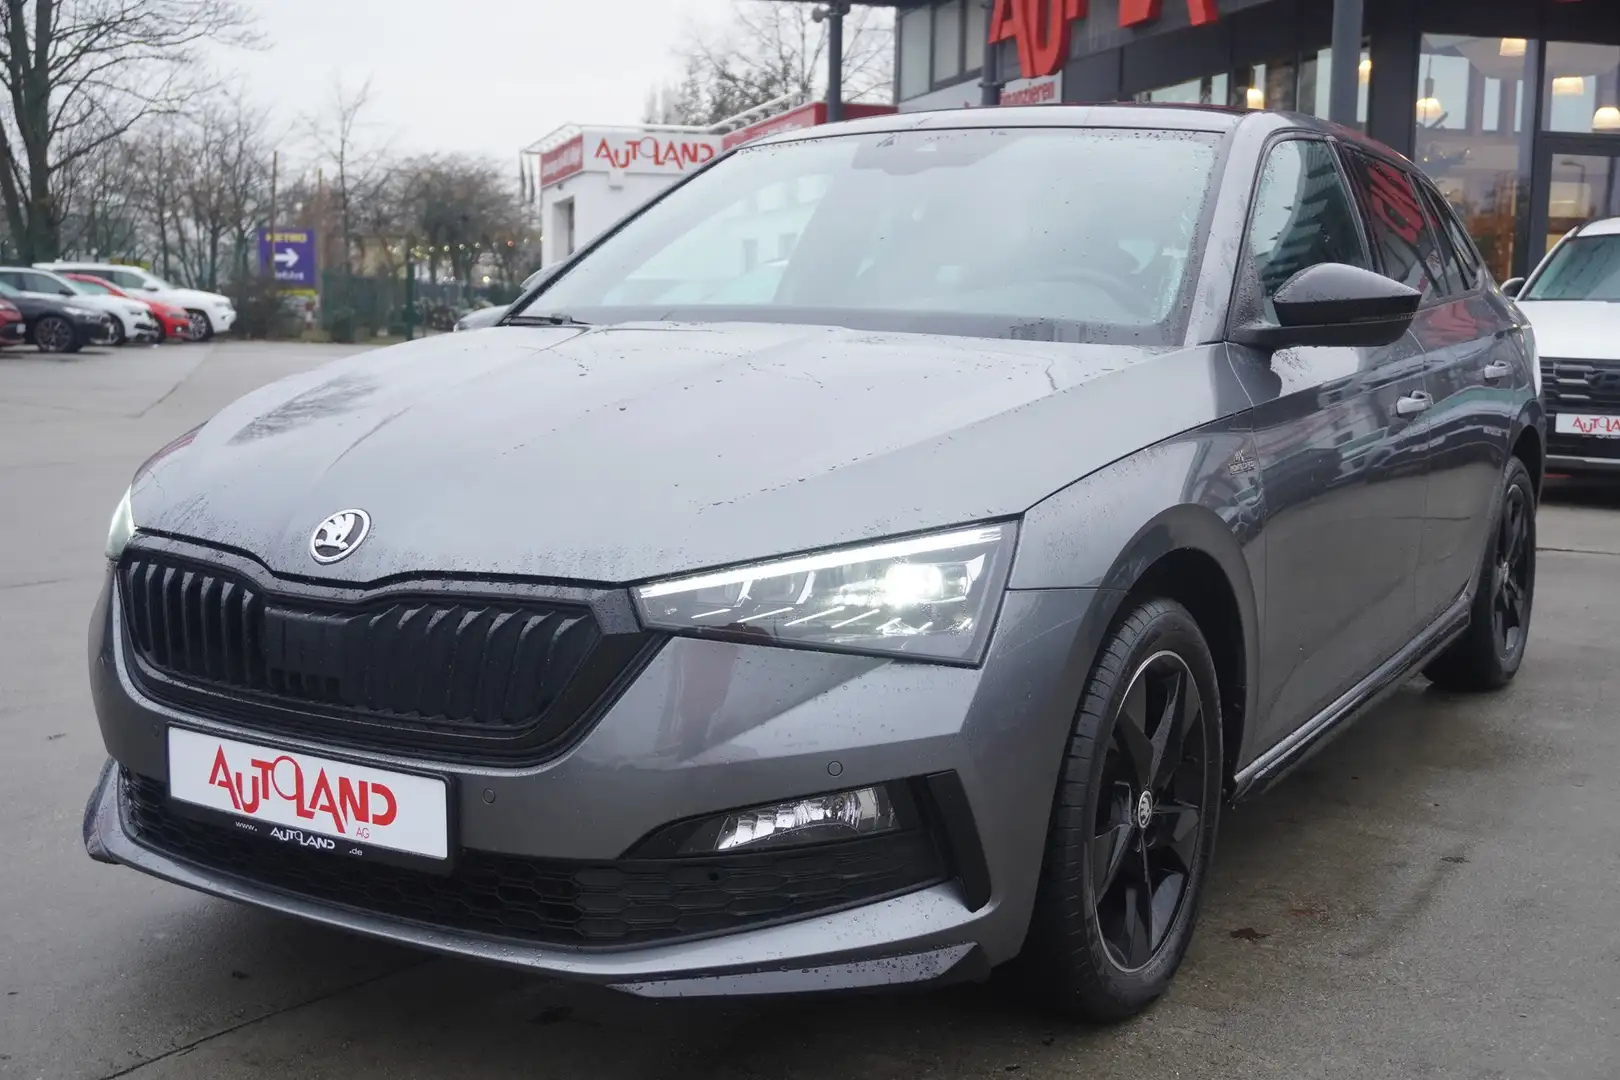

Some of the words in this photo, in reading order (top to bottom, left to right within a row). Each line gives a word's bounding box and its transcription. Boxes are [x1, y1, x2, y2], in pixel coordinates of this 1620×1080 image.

[594, 137, 714, 170] AUTOLAND
[209, 744, 398, 834] AUTOLAND
[235, 820, 259, 832] www.
[270, 826, 336, 850] AUTOLAND
[355, 826, 371, 840] AG
